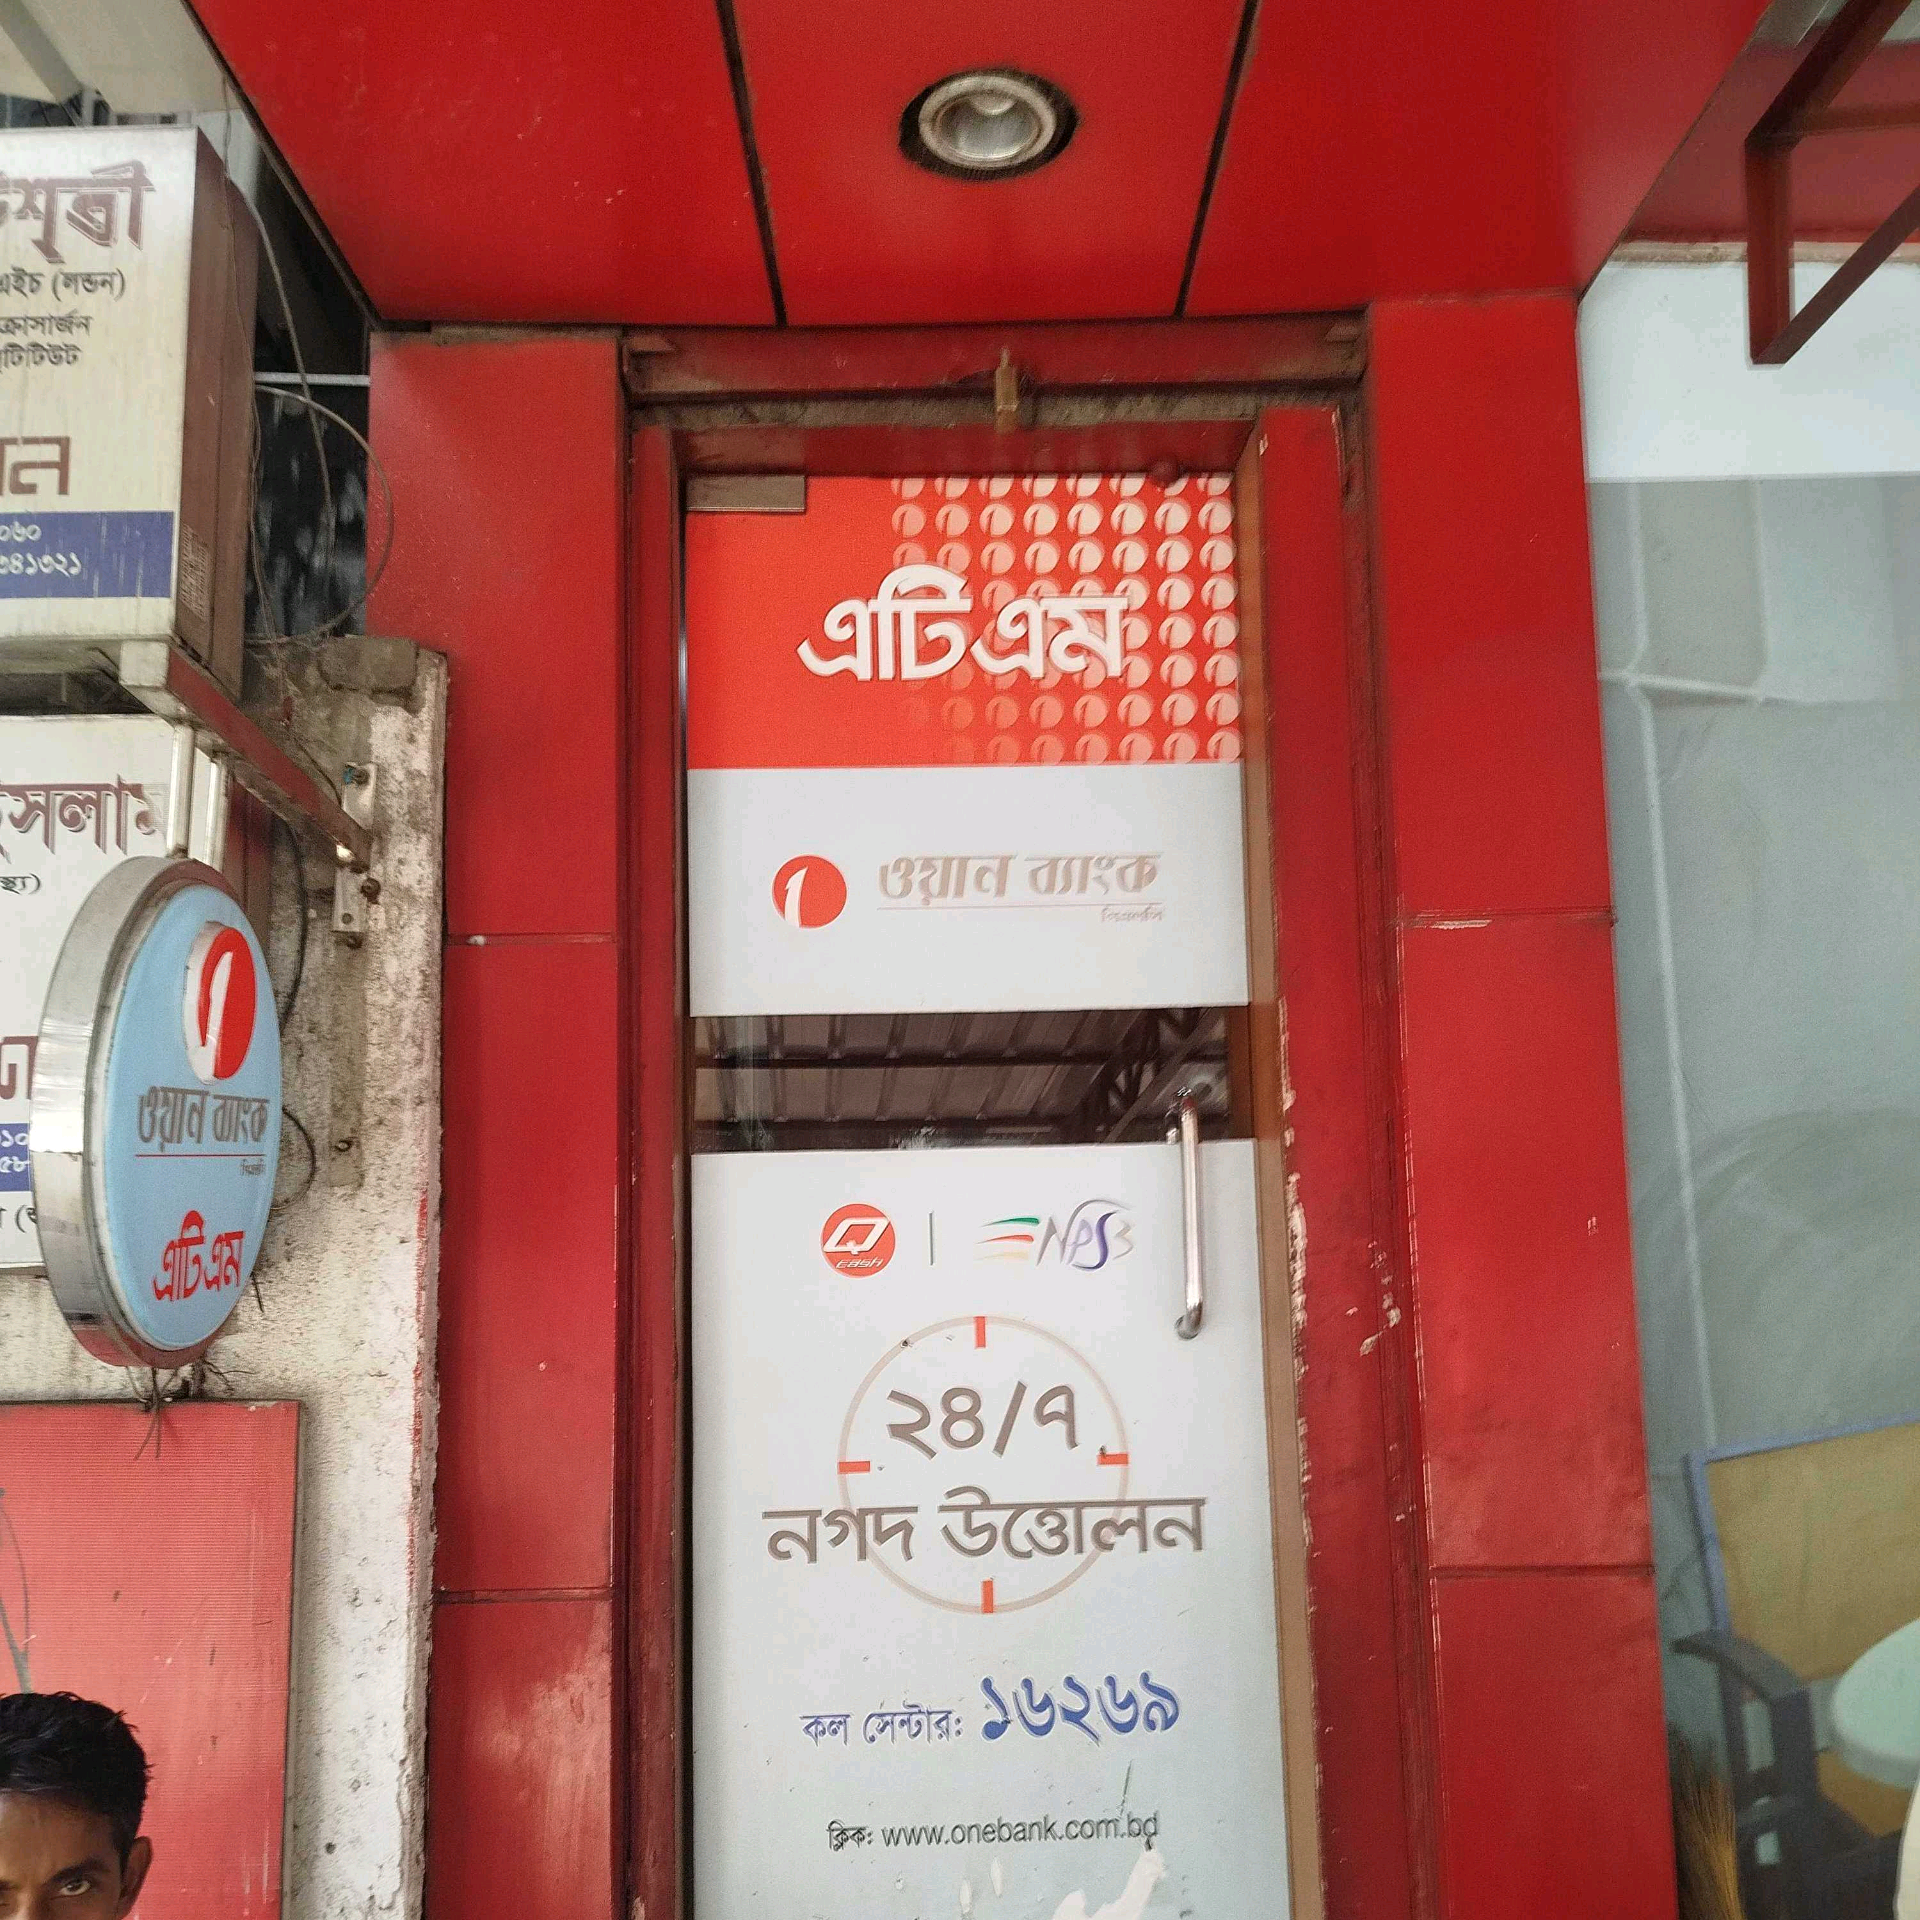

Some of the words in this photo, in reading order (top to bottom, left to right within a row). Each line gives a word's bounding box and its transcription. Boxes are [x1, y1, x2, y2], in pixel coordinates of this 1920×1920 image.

[879, 854, 1018, 906] ওয়ান
[1024, 852, 1164, 897] ব্যাংক
[885, 1380, 1080, 1460] ২৪/৭
[761, 1504, 918, 1565] নগদ
[937, 1484, 1207, 1561] উত্তোলন
[798, 1712, 851, 1747] কল
[980, 1671, 1181, 1747] ১৬২৬৯
[880, 1811, 1160, 1848] www.onebank.com.bd
